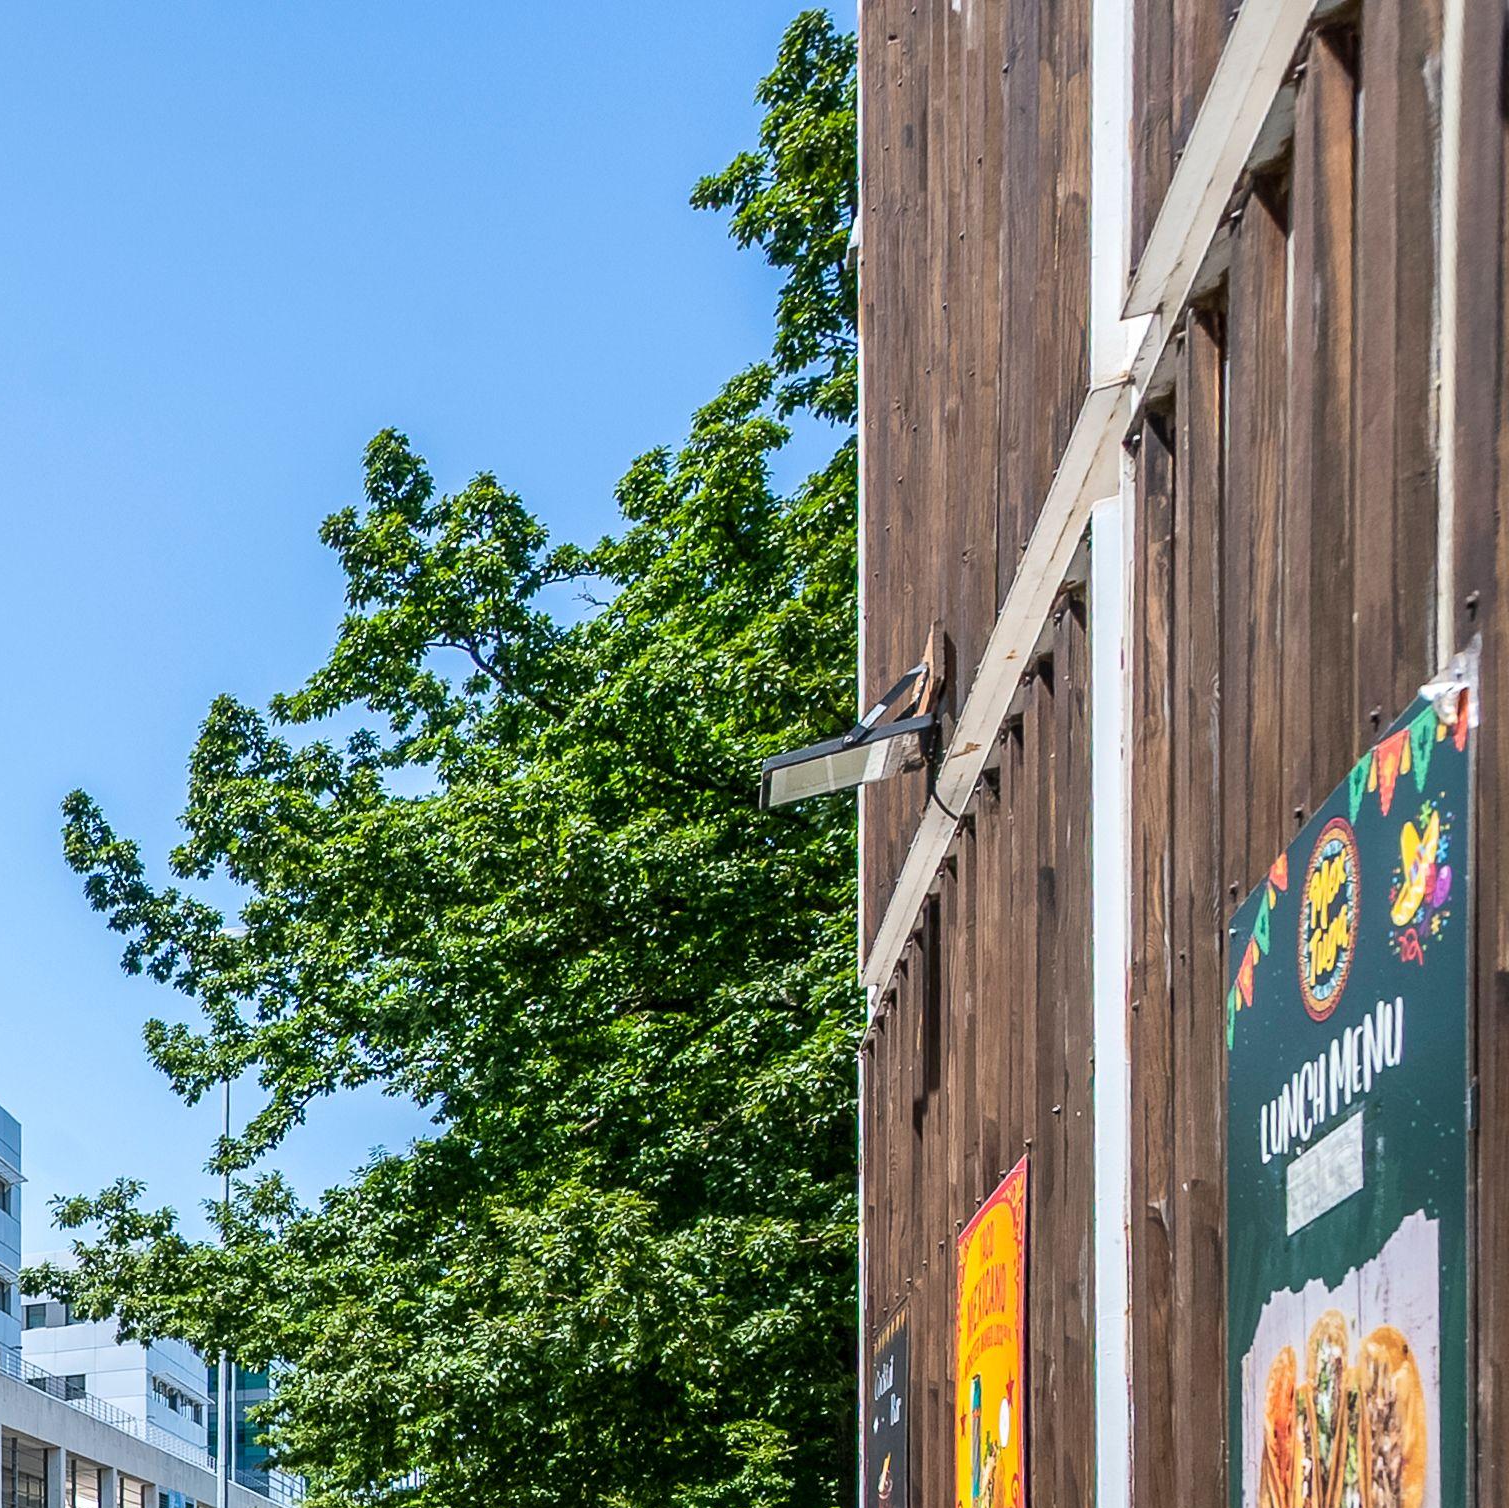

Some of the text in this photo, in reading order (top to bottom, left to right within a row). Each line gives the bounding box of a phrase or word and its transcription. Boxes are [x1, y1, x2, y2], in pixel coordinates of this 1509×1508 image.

[1308, 849, 1347, 930] Mex
[1260, 996, 1405, 1165] LUNCH MENU
